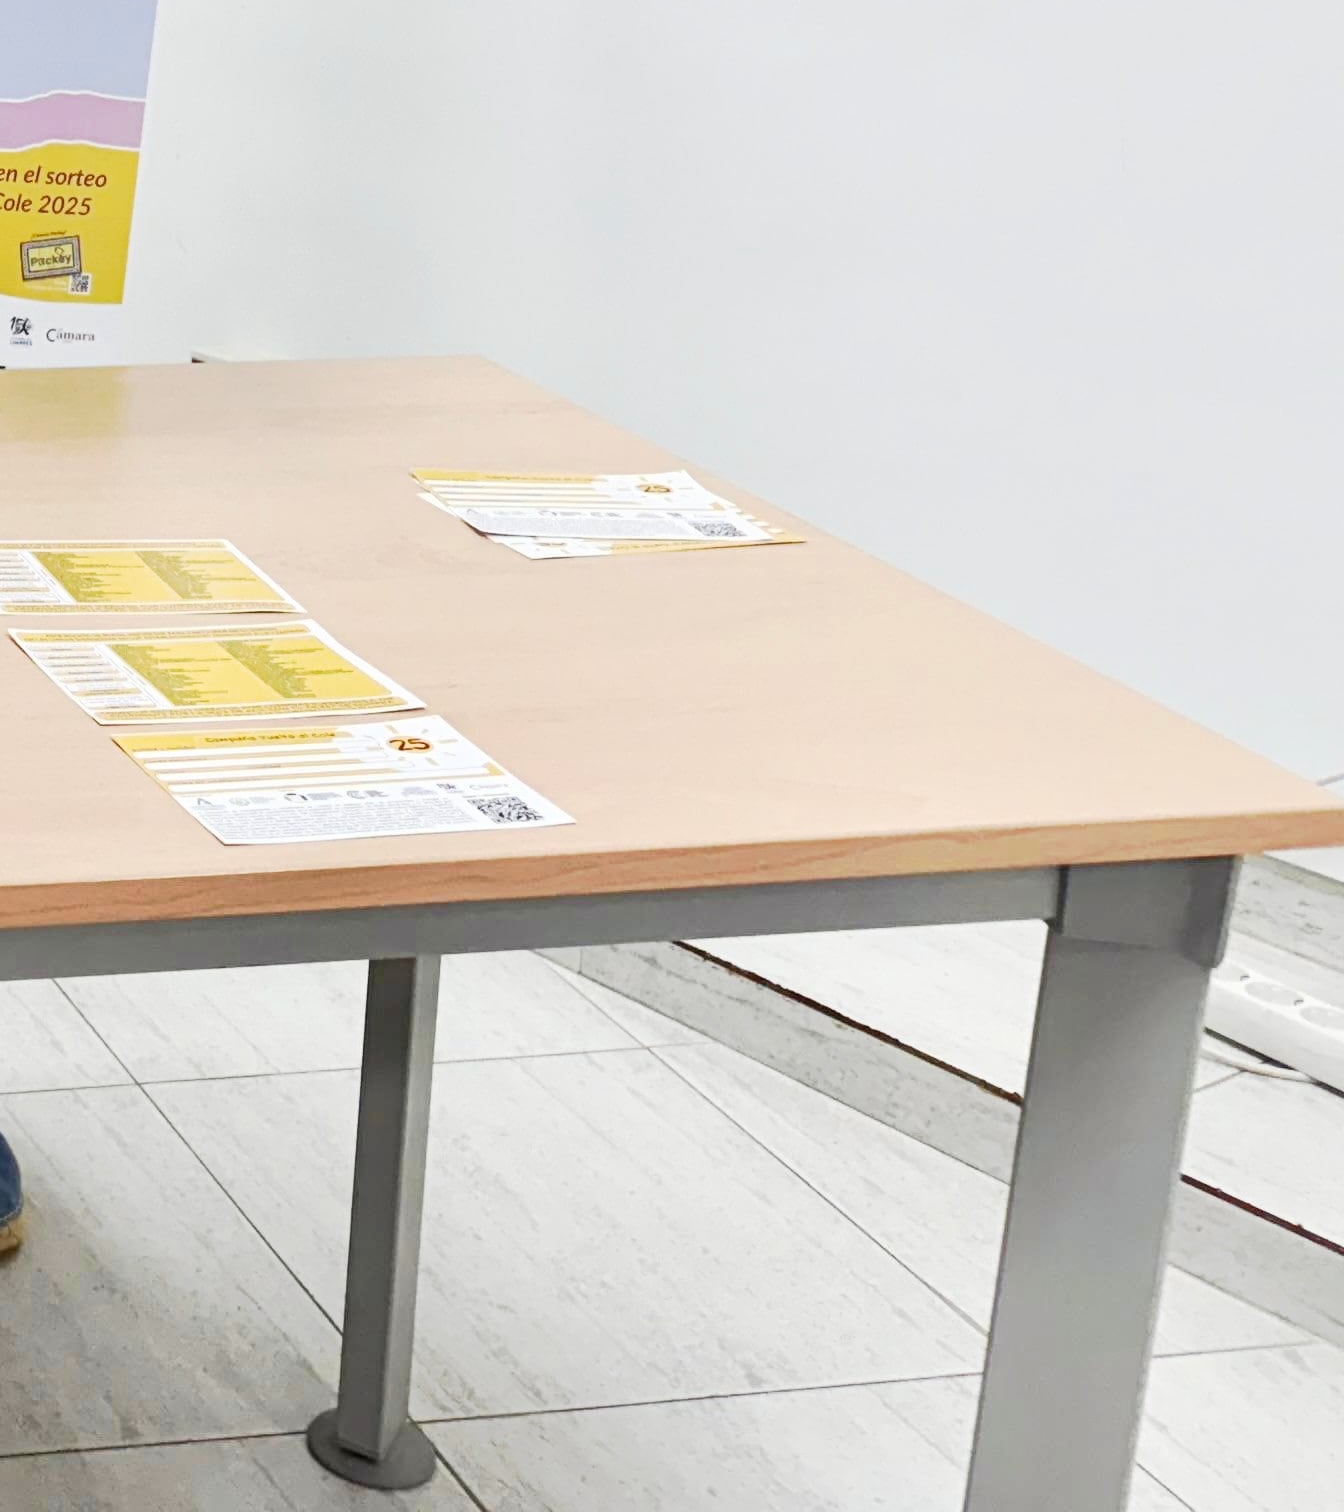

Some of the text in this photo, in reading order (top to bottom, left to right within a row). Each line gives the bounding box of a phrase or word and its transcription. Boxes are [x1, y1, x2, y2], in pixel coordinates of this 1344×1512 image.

[22, 163, 40, 184] el
[45, 168, 108, 188] sorteo
[37, 194, 92, 216] 2025
